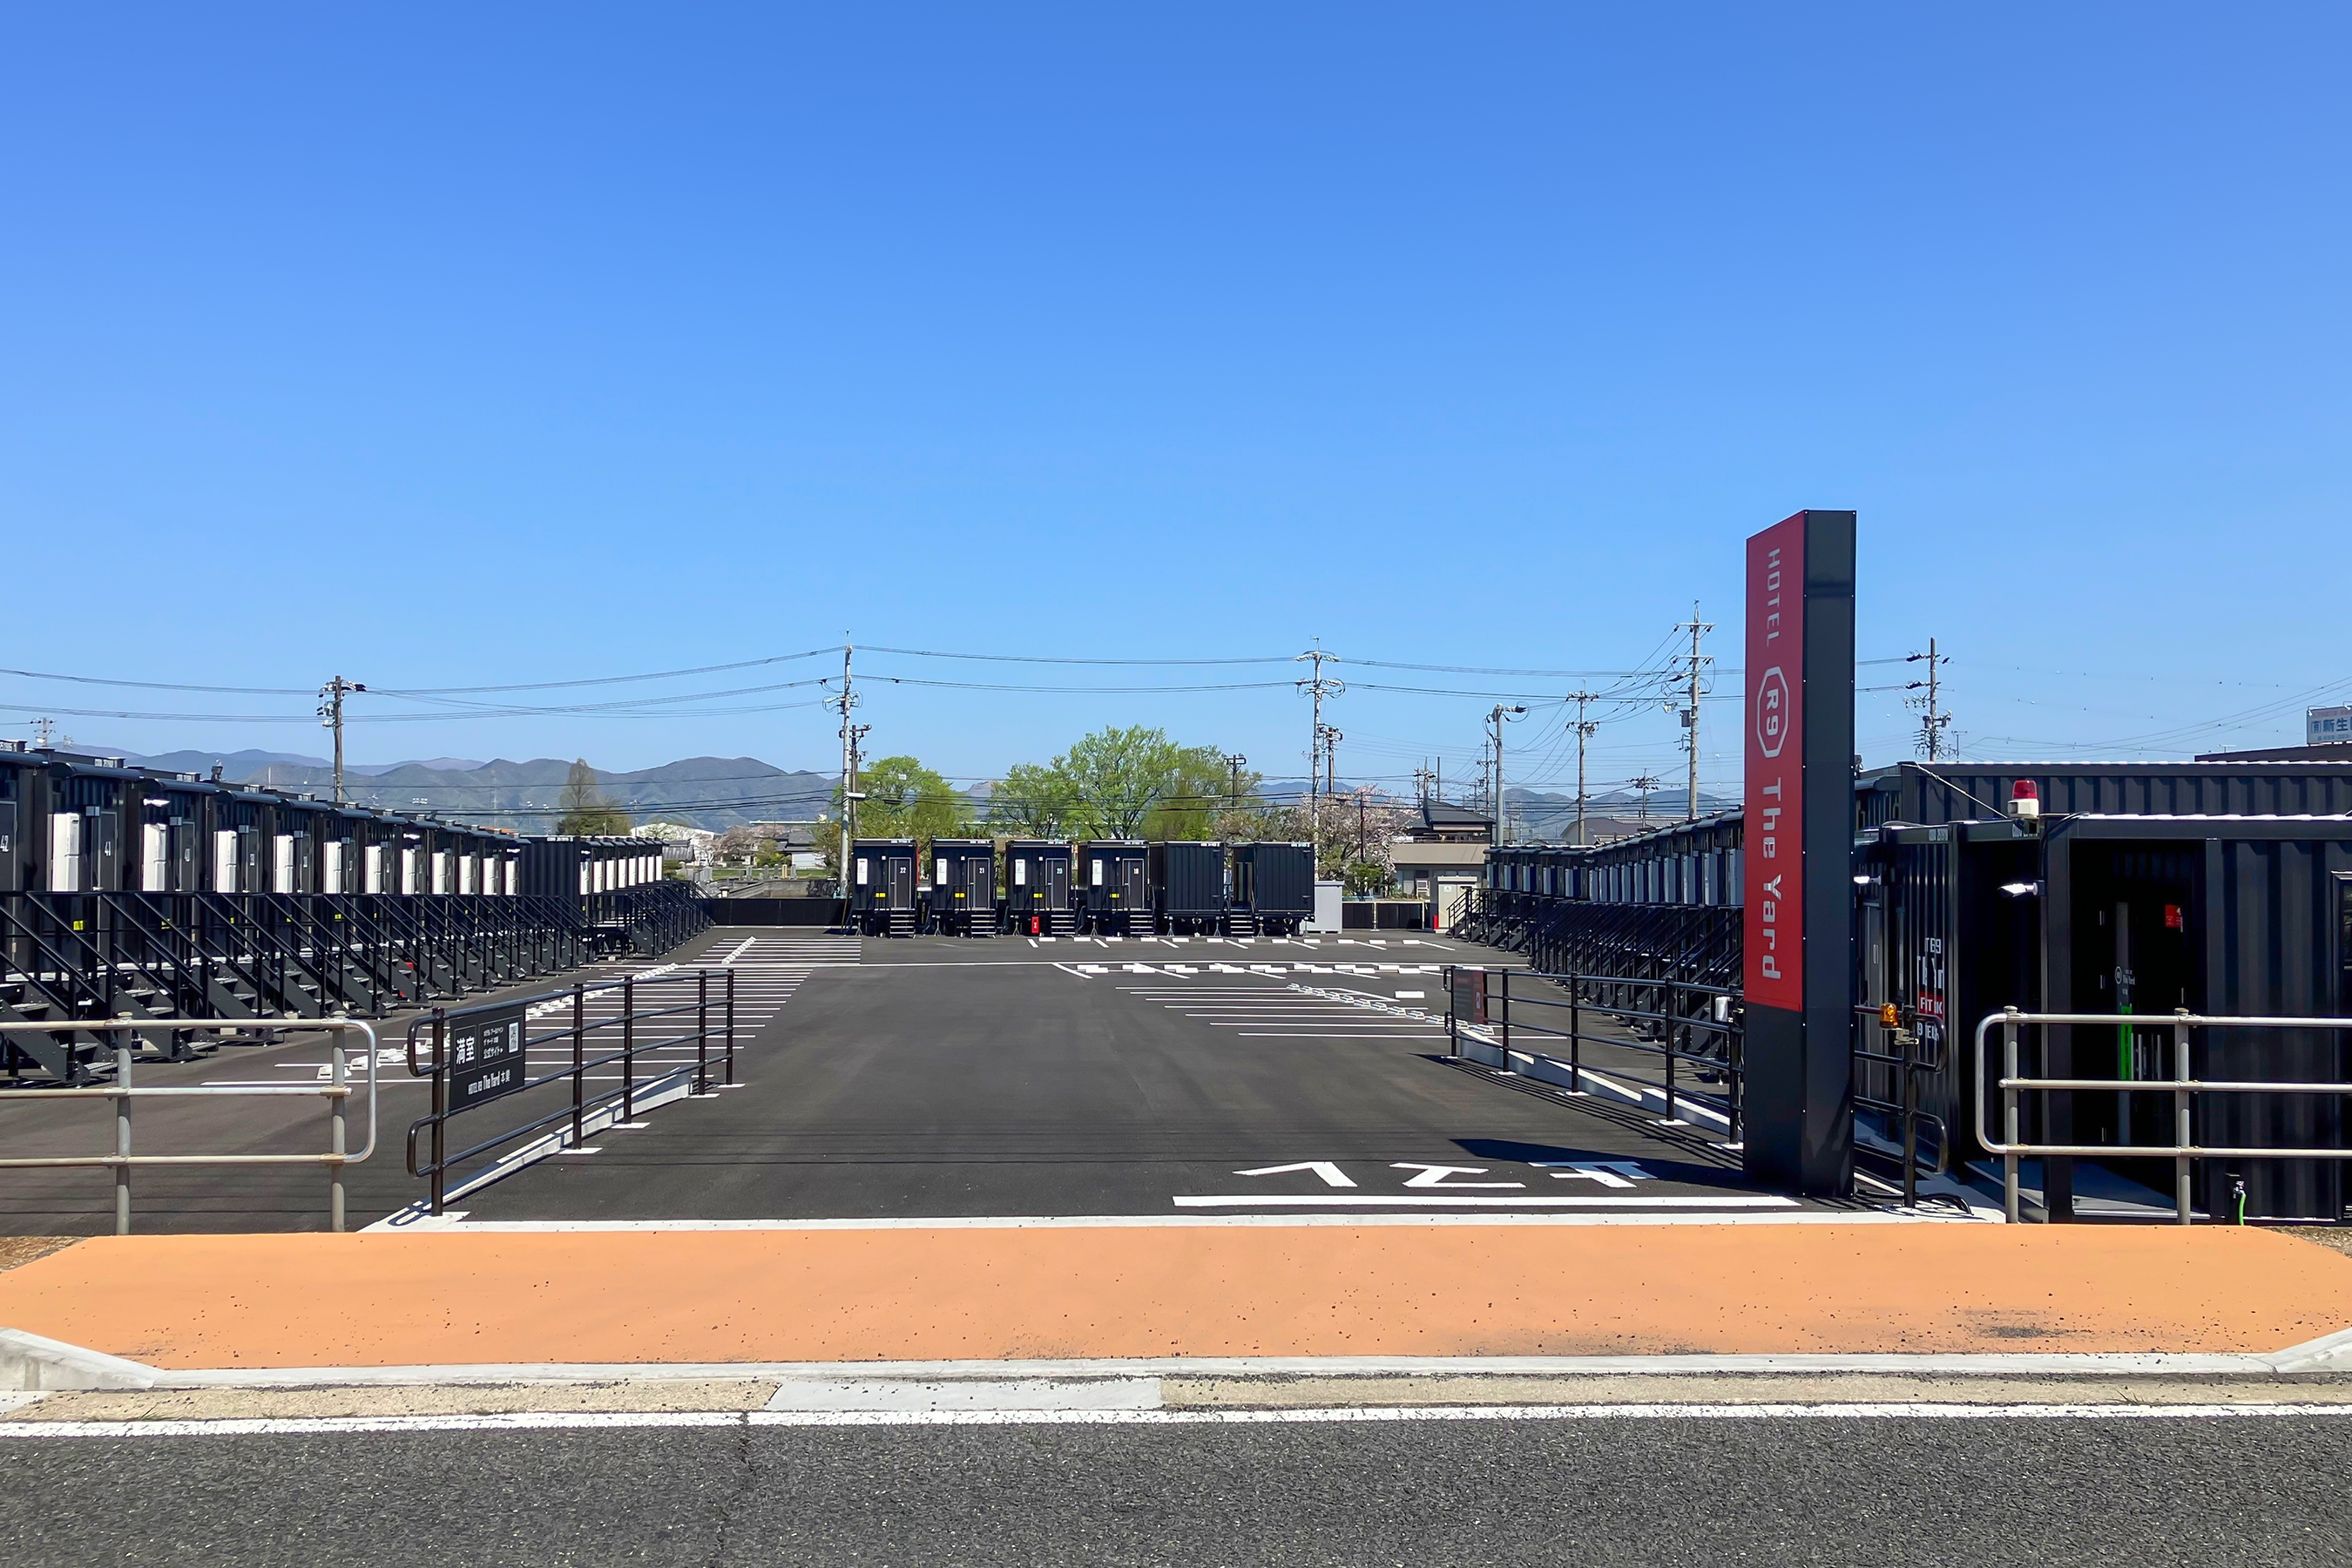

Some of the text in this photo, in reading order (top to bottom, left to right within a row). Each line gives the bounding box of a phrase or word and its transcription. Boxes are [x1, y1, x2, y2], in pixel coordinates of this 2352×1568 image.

[1761, 547, 1782, 980] HOTEL R9 The Yard
[104, 841, 112, 857] 41
[456, 1036, 475, 1064] 満室
[490, 1071, 501, 1088] Yard
